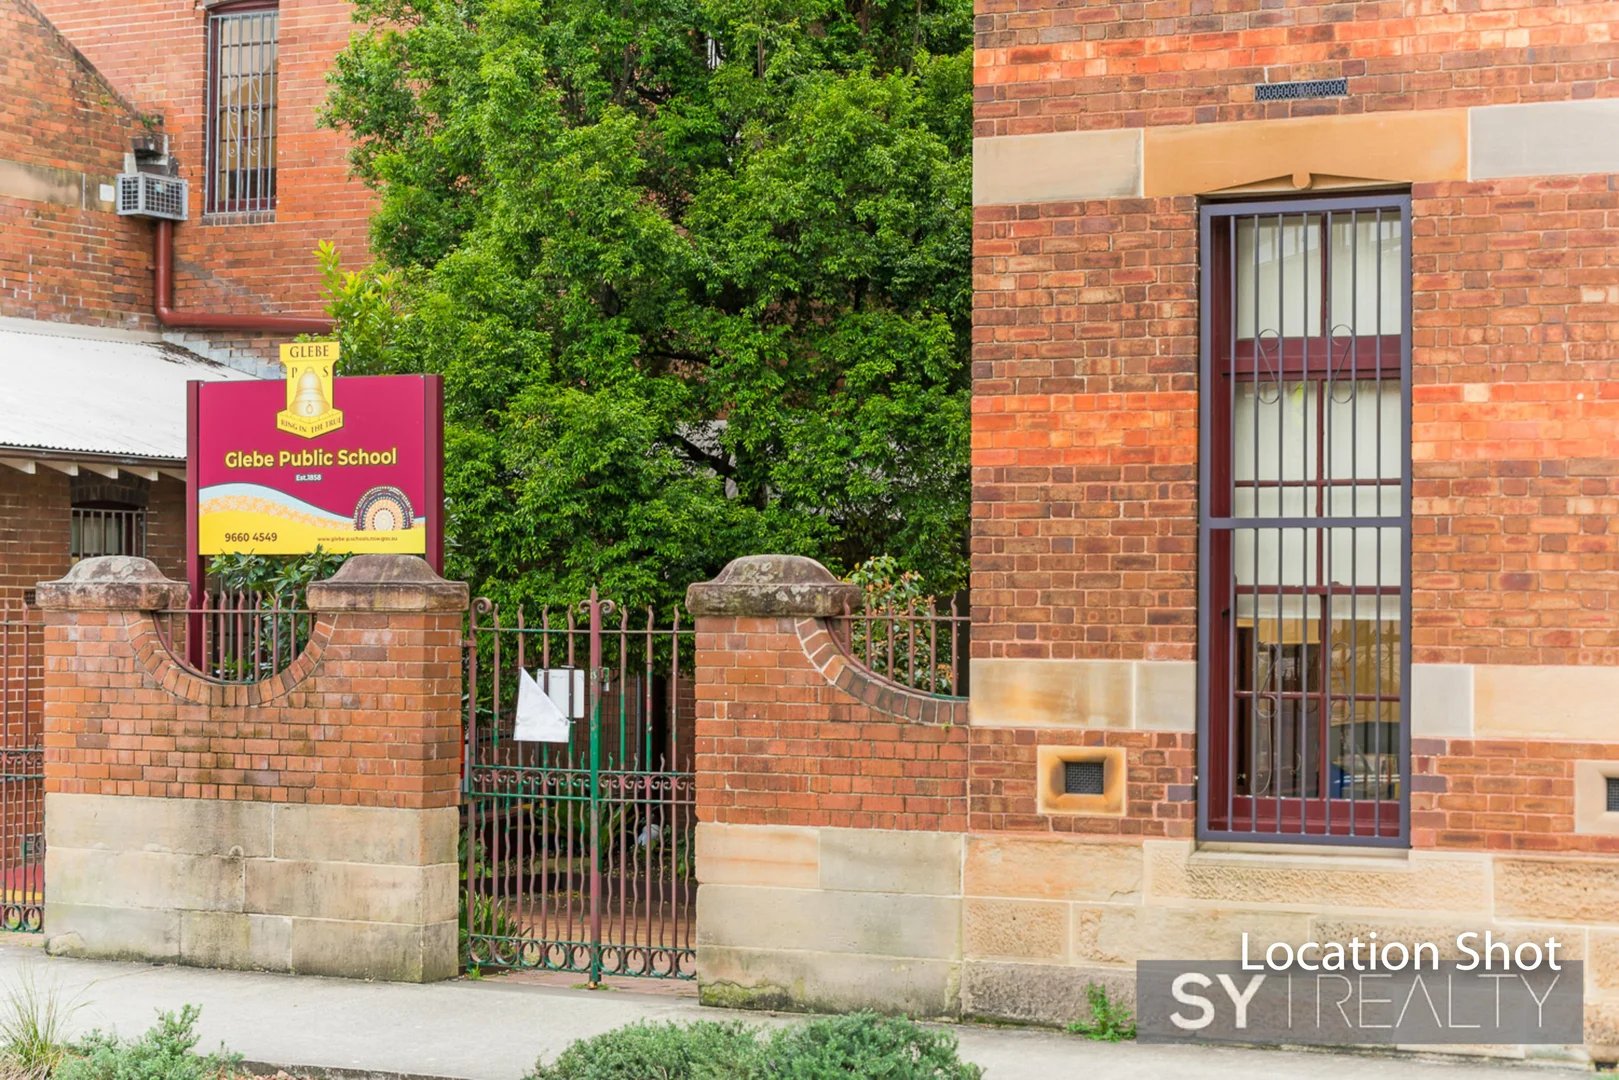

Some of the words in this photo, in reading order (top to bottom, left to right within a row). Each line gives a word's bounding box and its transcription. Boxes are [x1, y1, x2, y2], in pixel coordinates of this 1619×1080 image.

[289, 345, 329, 358] GLEBE
[291, 367, 298, 378] P
[322, 365, 329, 377] S
[225, 451, 275, 468] Glebe
[279, 449, 333, 467] Public
[337, 447, 397, 466] School
[224, 532, 250, 543] 9660
[252, 532, 278, 542] 4549
